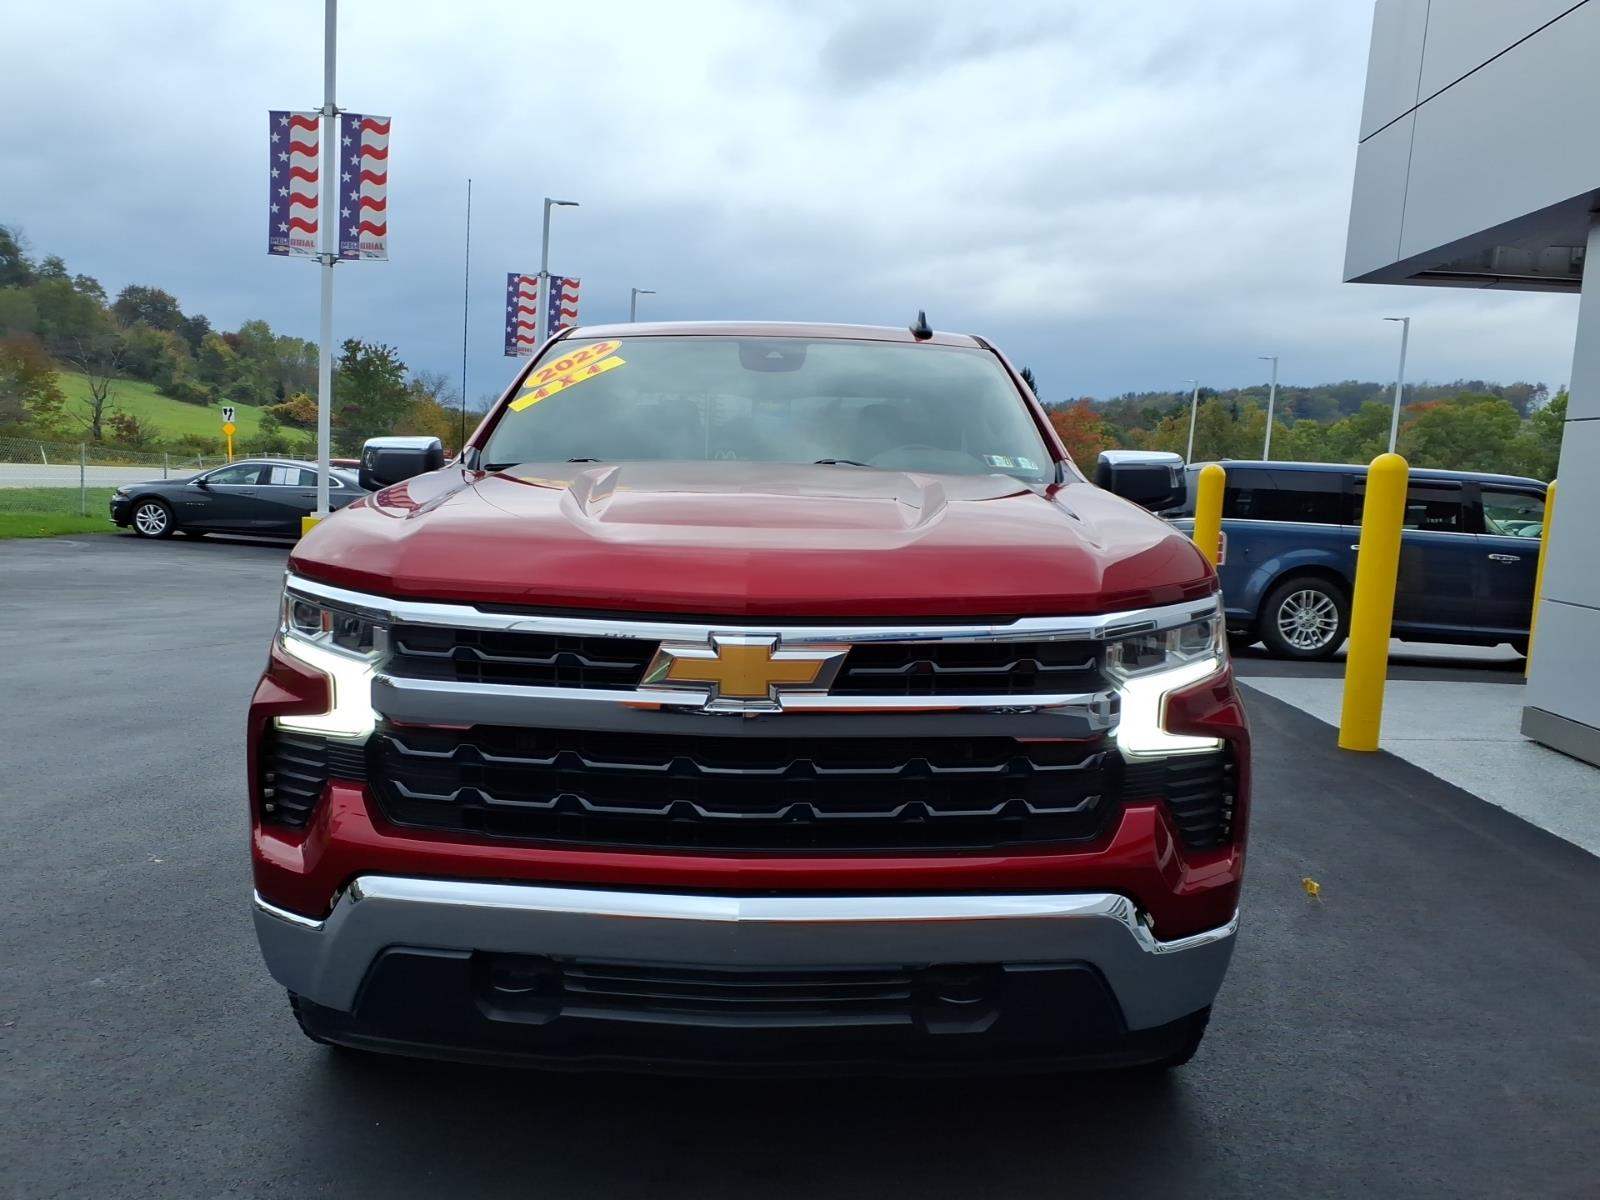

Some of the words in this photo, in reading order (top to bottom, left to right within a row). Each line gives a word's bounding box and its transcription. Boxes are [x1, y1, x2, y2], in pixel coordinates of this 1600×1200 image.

[536, 342, 613, 383] 2022
[534, 387, 549, 400] 4
[587, 364, 601, 375] 4
